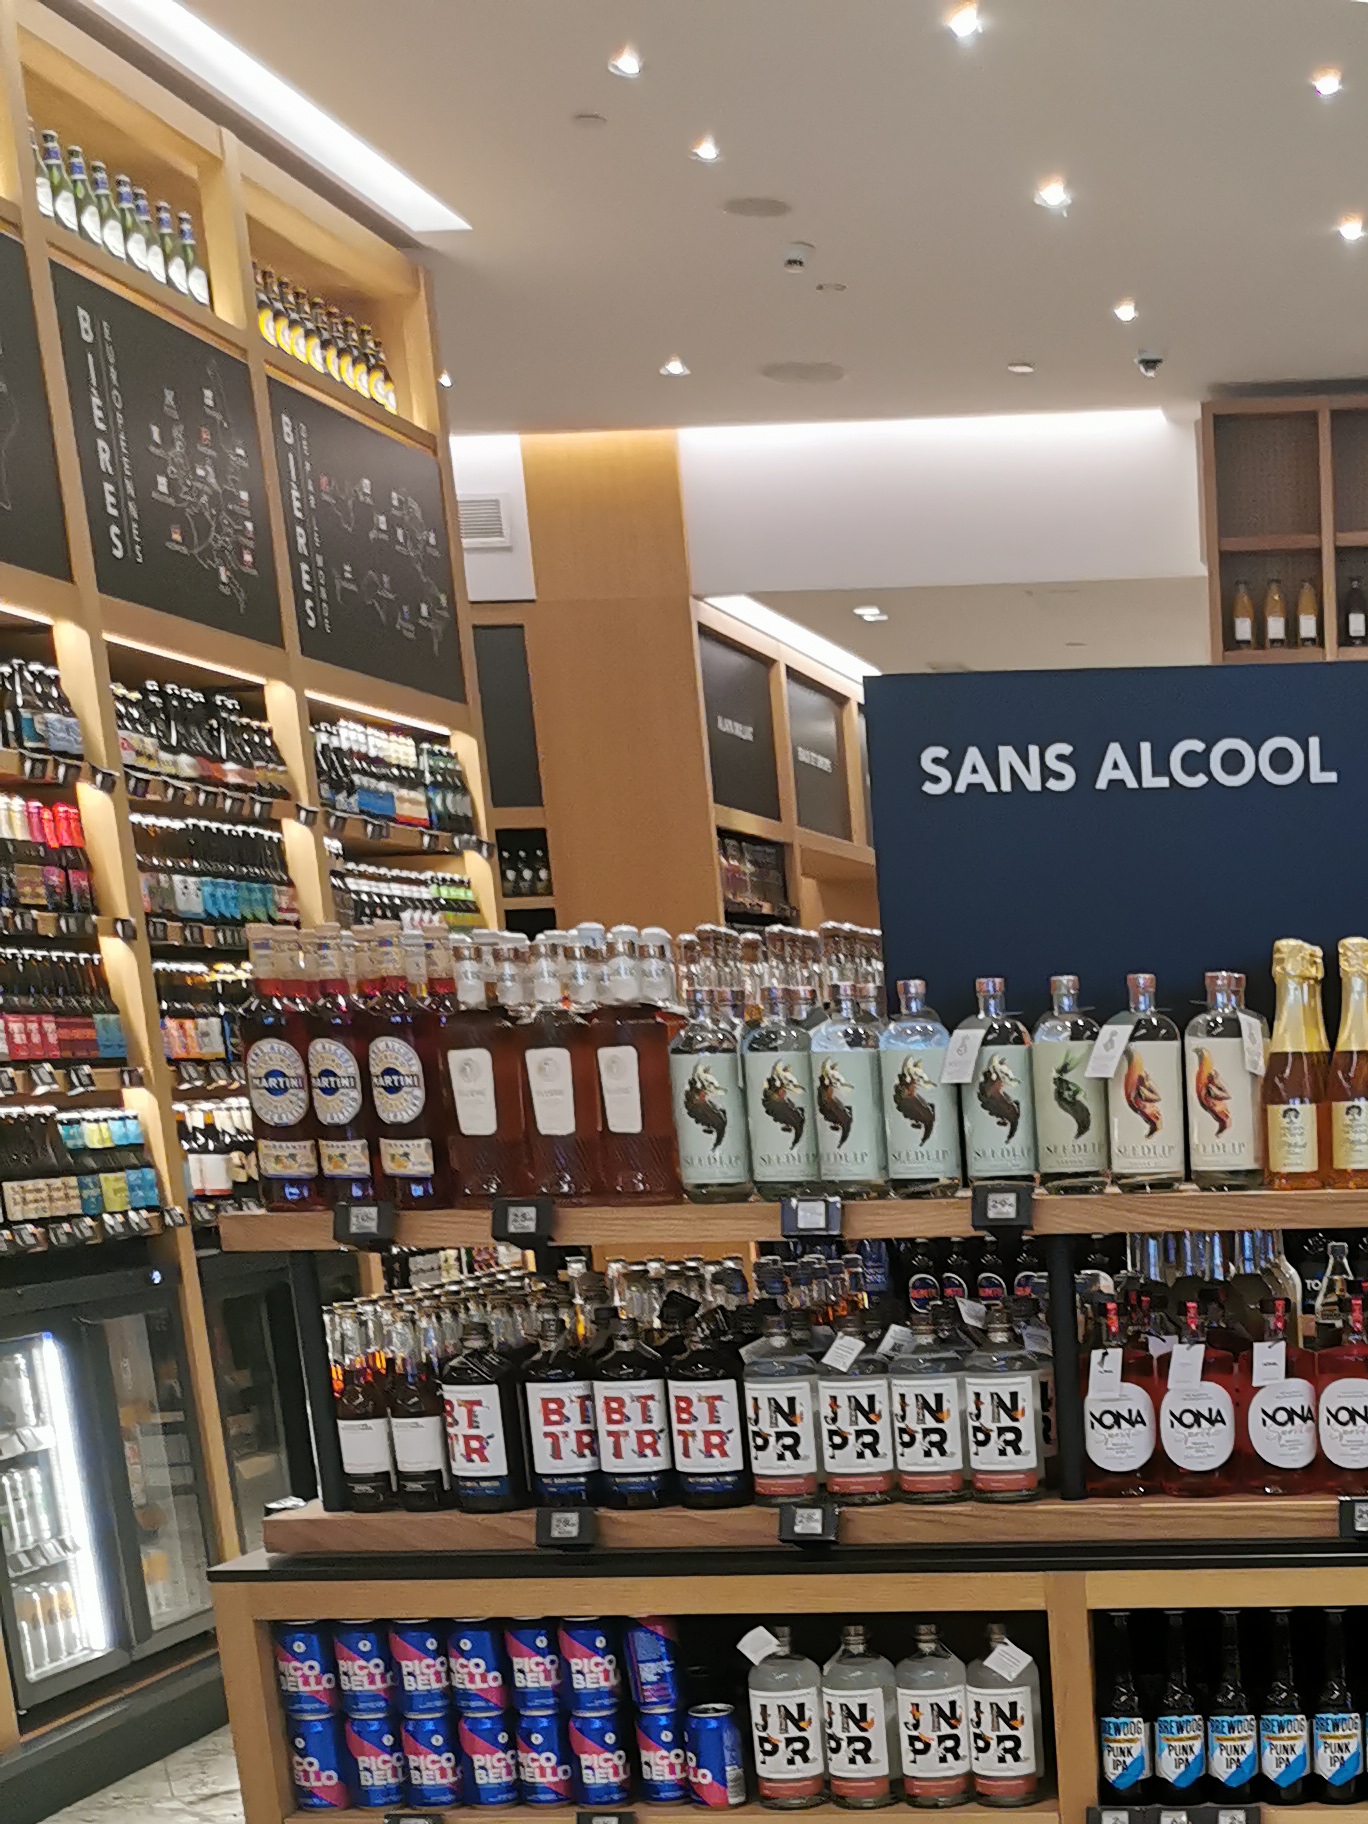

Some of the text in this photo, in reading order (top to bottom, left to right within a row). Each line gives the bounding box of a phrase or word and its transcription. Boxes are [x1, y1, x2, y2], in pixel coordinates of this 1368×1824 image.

[919, 735, 1338, 796] SANS ALCOOL
[1089, 1407, 1147, 1430] NONA
[1168, 1407, 1226, 1430] NONA
[339, 1657, 384, 1675] PICO
[513, 1654, 559, 1673] PICO
[570, 1654, 617, 1674] PICO
[1107, 1744, 1134, 1758] PUNK
[1167, 1743, 1195, 1757] PUNK
[1219, 1743, 1247, 1757] PUNK
[1269, 1742, 1297, 1756] PUNK
[1322, 1741, 1351, 1755] PUNK
[408, 1752, 456, 1771] PICO
[580, 1750, 626, 1769] PICO
[1112, 1758, 1129, 1771] IPA
[1174, 1757, 1190, 1770] IPA
[1225, 1757, 1241, 1770] IPA
[1275, 1756, 1291, 1769] IPA
[1328, 1755, 1345, 1768] IPA
